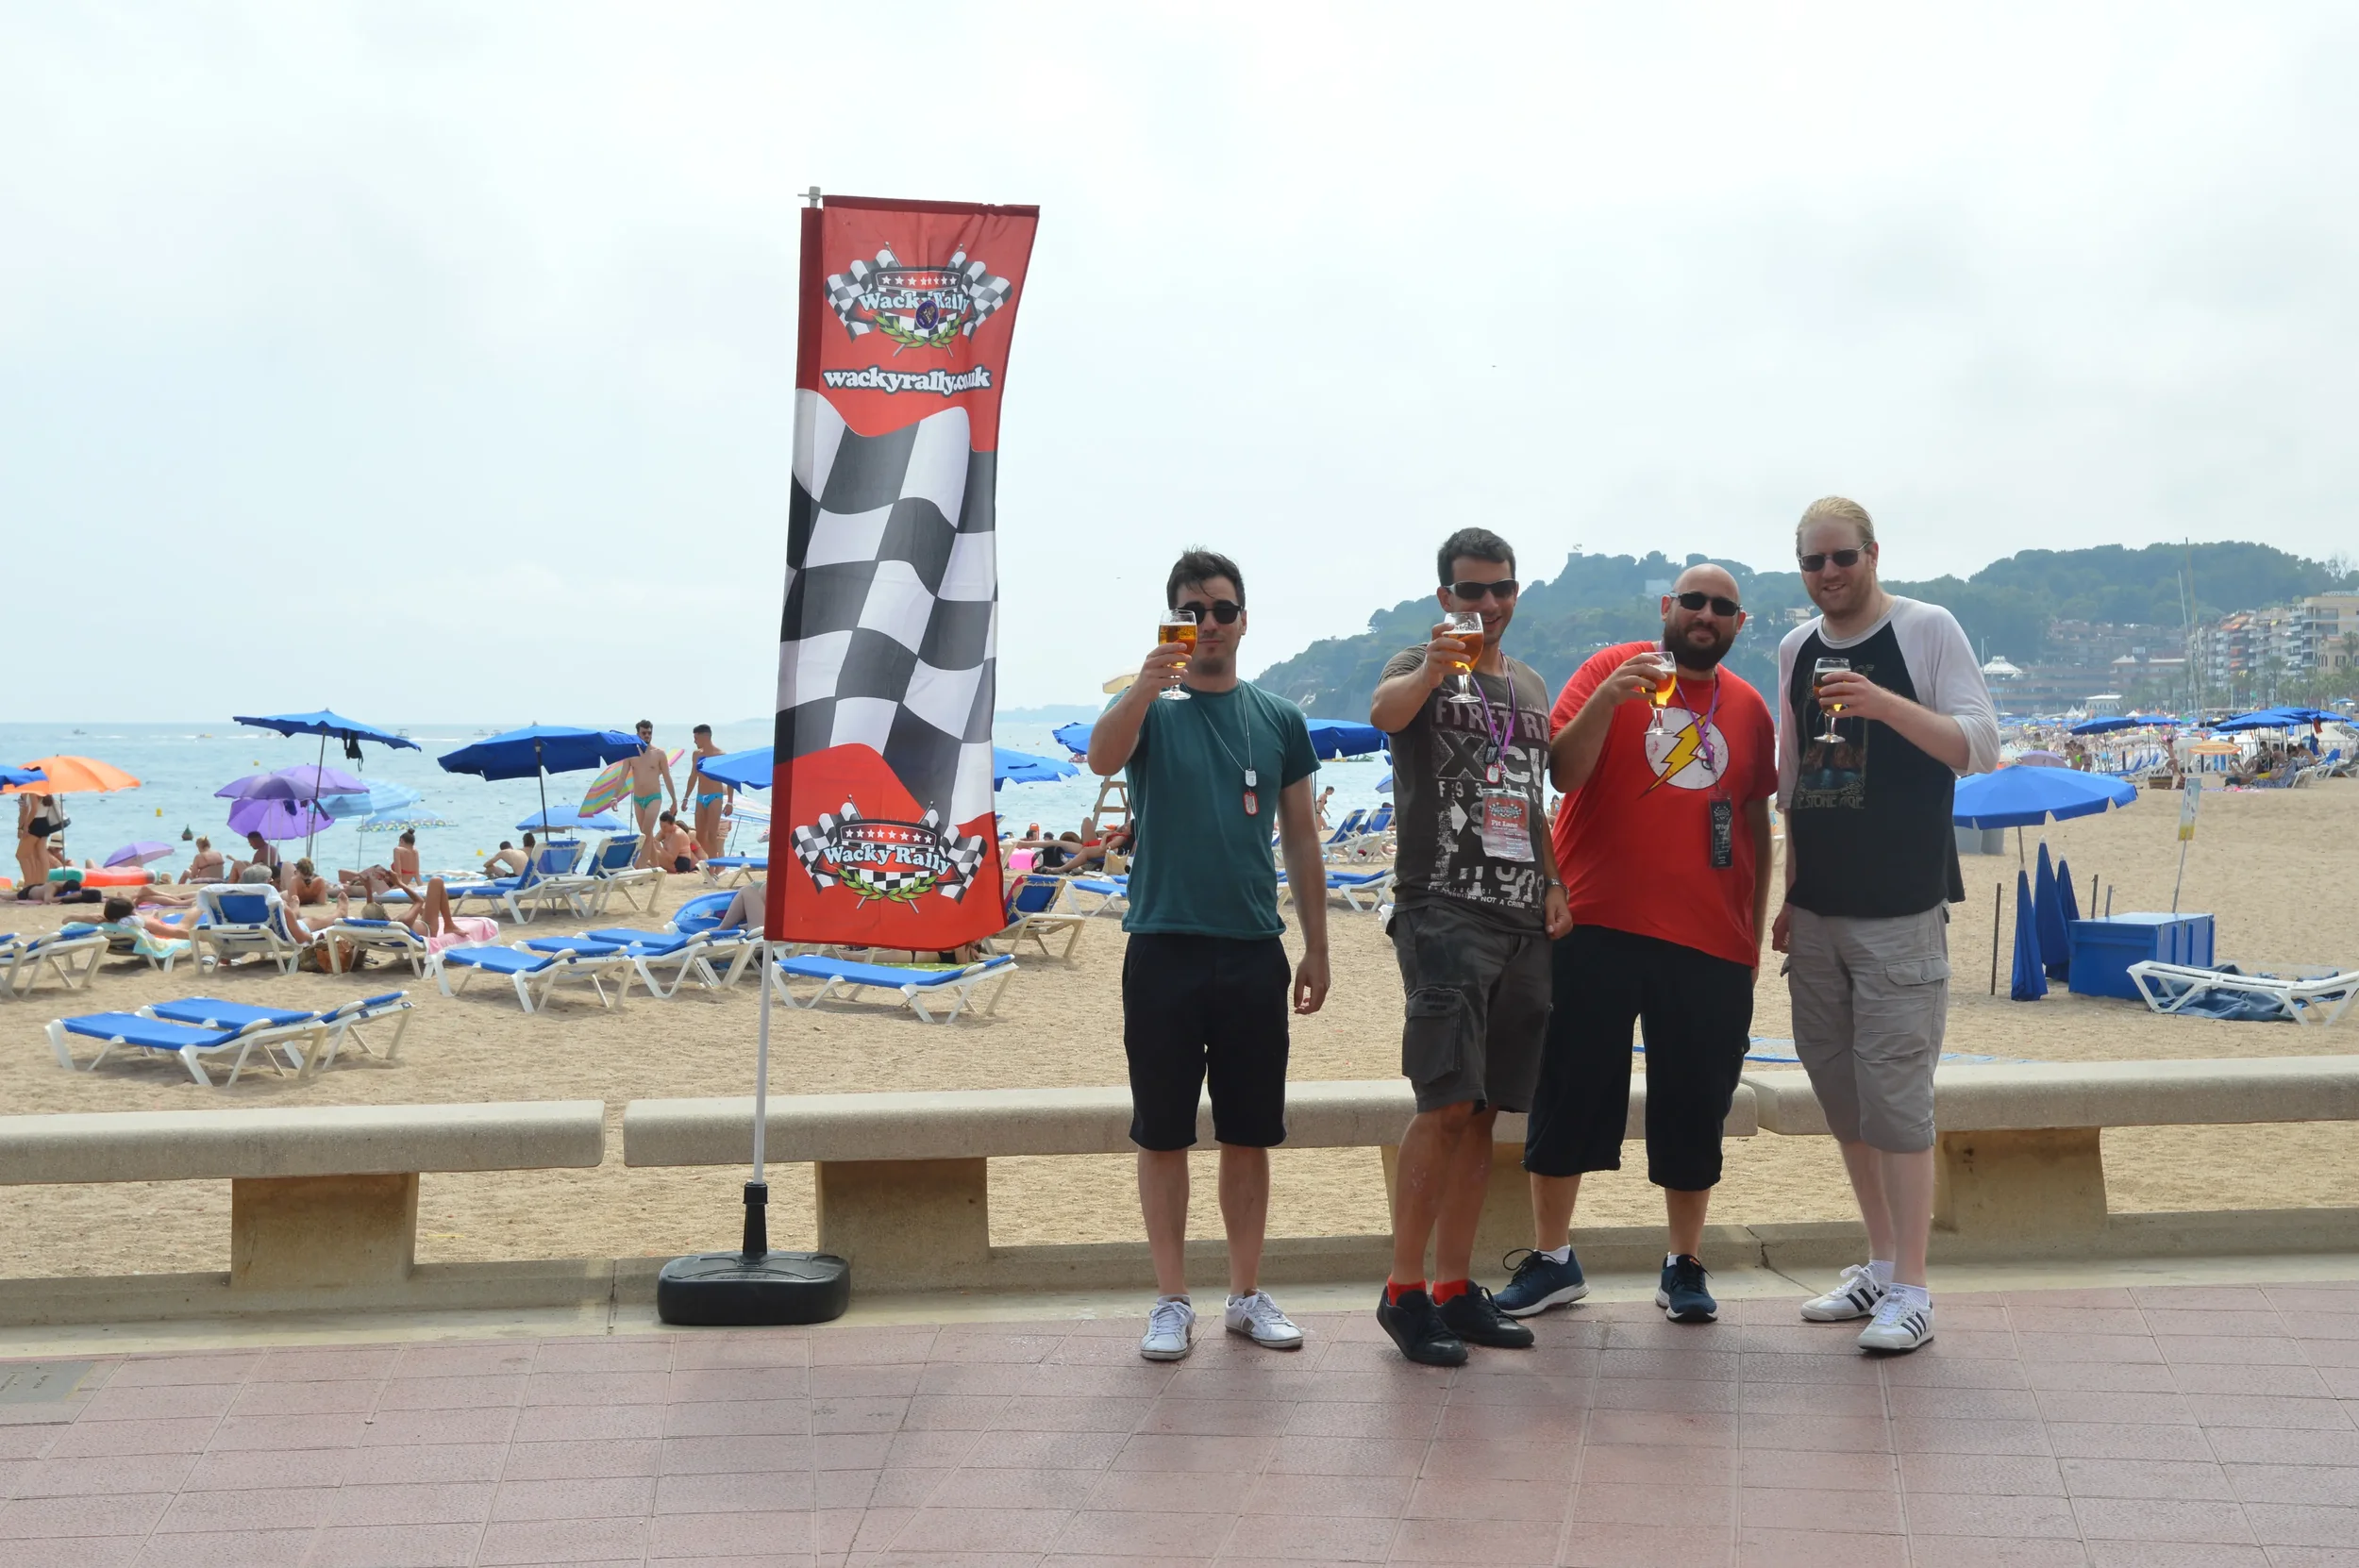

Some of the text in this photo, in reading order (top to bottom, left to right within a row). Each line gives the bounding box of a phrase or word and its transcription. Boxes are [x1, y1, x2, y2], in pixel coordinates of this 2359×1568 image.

[932, 291, 971, 314] Rally
[822, 843, 952, 876] Wacky Rally
[1481, 895, 1497, 904] NOT
